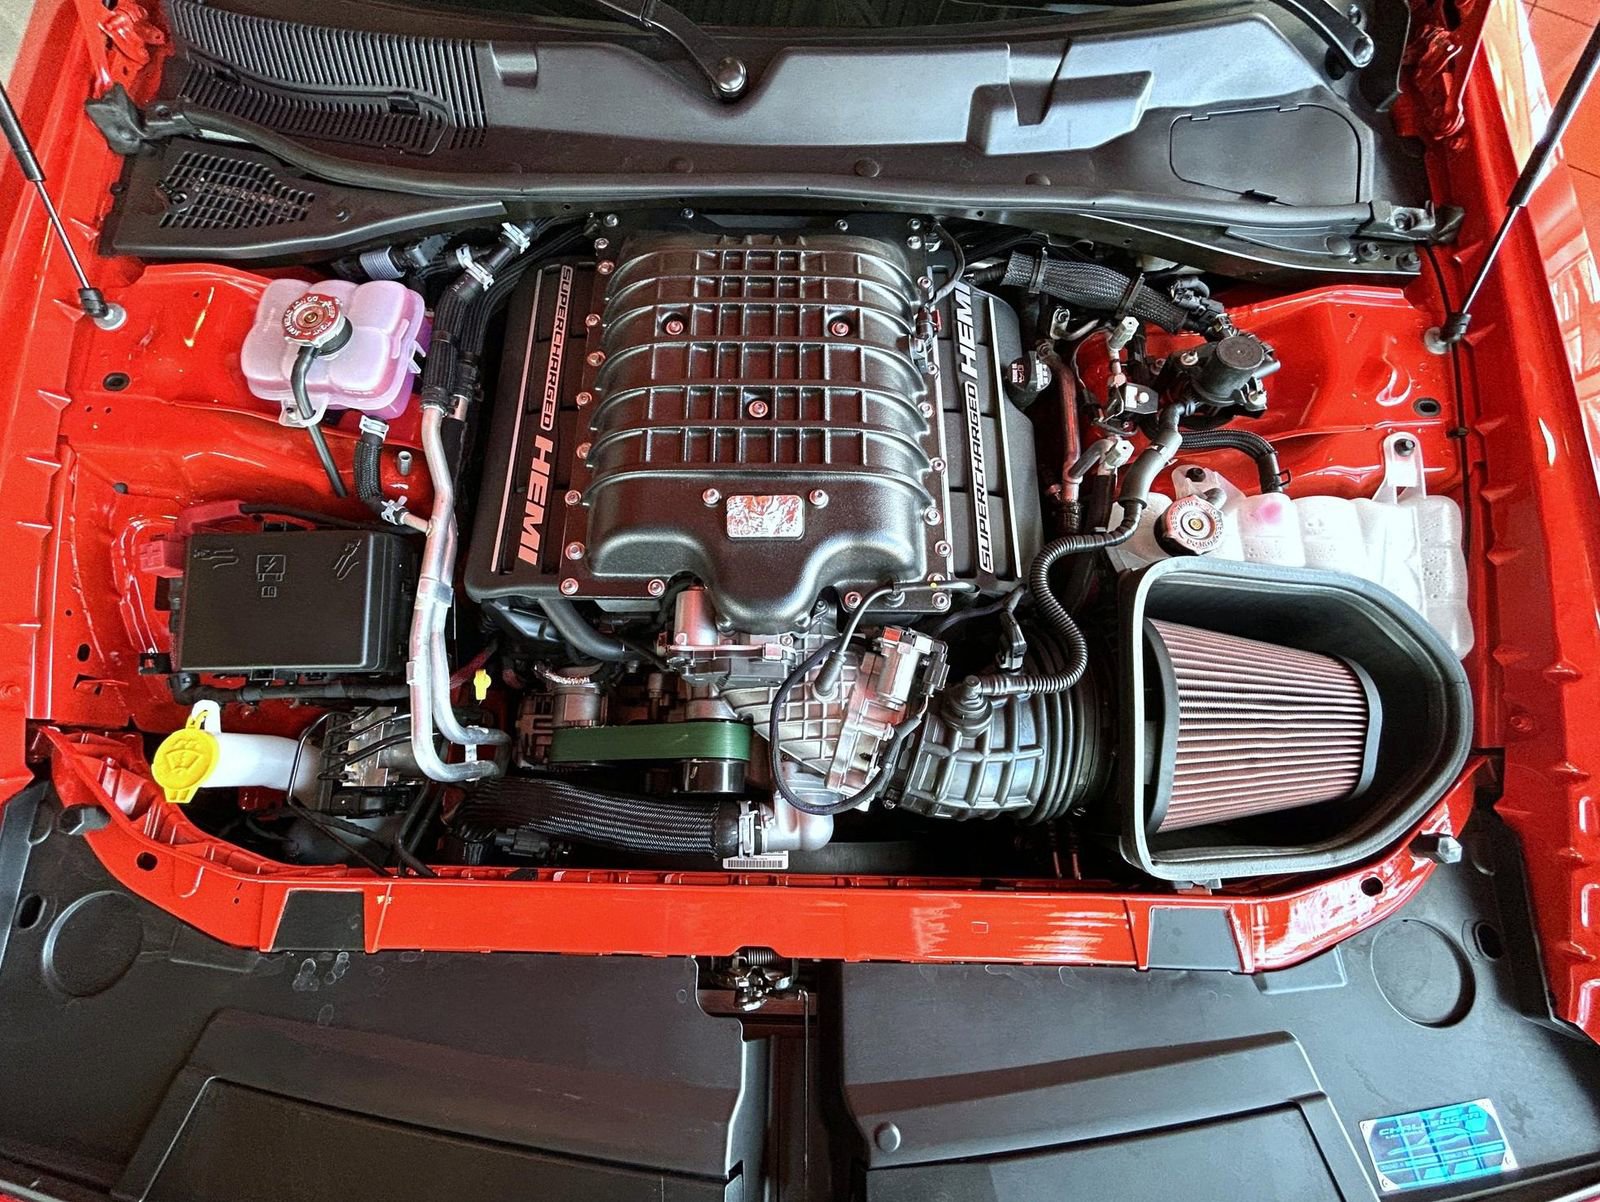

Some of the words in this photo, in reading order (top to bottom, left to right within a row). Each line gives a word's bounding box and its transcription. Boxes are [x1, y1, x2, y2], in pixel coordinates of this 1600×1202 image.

[540, 265, 573, 430] SUPERCHARGED
[955, 281, 978, 379] HEMI
[518, 435, 554, 565] HEMI
[964, 381, 994, 574] SUPERCHARGED
